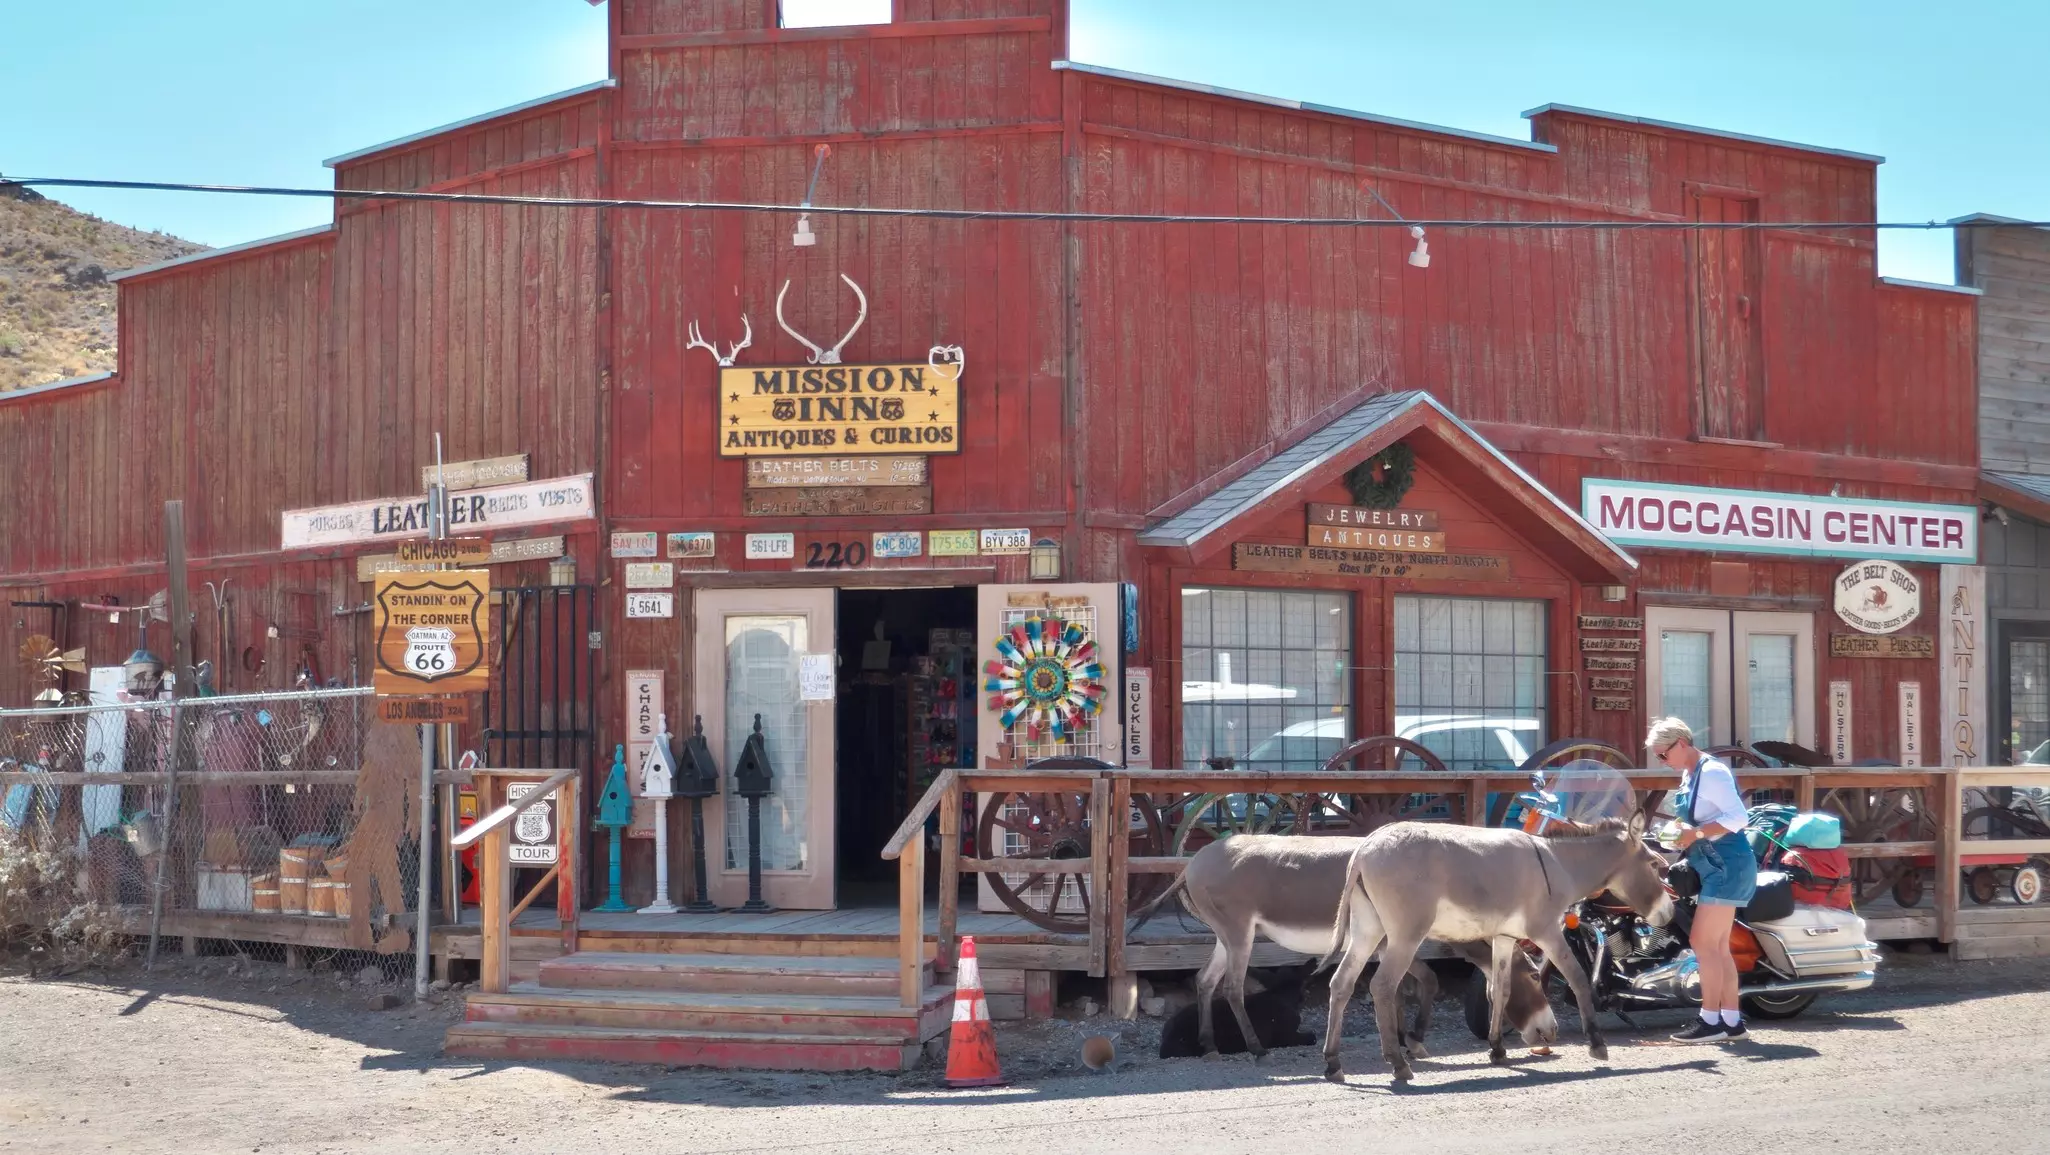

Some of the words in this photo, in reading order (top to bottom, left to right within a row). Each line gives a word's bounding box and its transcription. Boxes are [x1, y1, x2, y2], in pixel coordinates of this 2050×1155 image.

[752, 367, 926, 395] MISSION
[797, 397, 880, 422] INN
[725, 428, 836, 450] ANTIQUES
[844, 428, 858, 445] &
[870, 426, 953, 445] CURIOS
[751, 460, 823, 474] LEATHER
[830, 459, 880, 472] BELTS
[373, 495, 487, 534] LEATER
[1326, 509, 1424, 527] JEWELRY
[1600, 494, 1811, 541] MOCCASIN
[1823, 510, 1964, 550] CENTER
[1323, 531, 1431, 548] ANTIQUES
[402, 540, 457, 561] CHICAGO
[807, 541, 866, 568] 220
[1246, 544, 1302, 559] LEATHER
[1309, 548, 1347, 561] BELTS
[1353, 550, 1384, 563] MADE
[1390, 552, 1403, 563] IN
[1409, 553, 1448, 565] NORTH
[1454, 555, 1499, 569] DAKOTA
[1380, 565, 1391, 575] to
[1841, 569, 1861, 592] THE
[1863, 564, 1887, 581] BELT
[1890, 568, 1917, 594] SHOP
[391, 595, 447, 606] STANDIN'
[449, 595, 467, 606] ON
[639, 600, 662, 614] 5641
[393, 614, 416, 625] THE
[420, 613, 469, 625] CORNER
[1841, 606, 1863, 626] LEATHER
[440, 632, 449, 640] AZ
[1833, 637, 1880, 653] LEATHER
[1890, 636, 1932, 653] PURSES
[415, 653, 445, 671] 66
[386, 702, 403, 720] LOS
[639, 683, 651, 735] CHAPS
[1130, 682, 1141, 756] BUCKLES
[1836, 691, 1845, 760] HOLSTERS
[1905, 692, 1915, 751] WALLETS
[515, 848, 550, 859] TOUR
